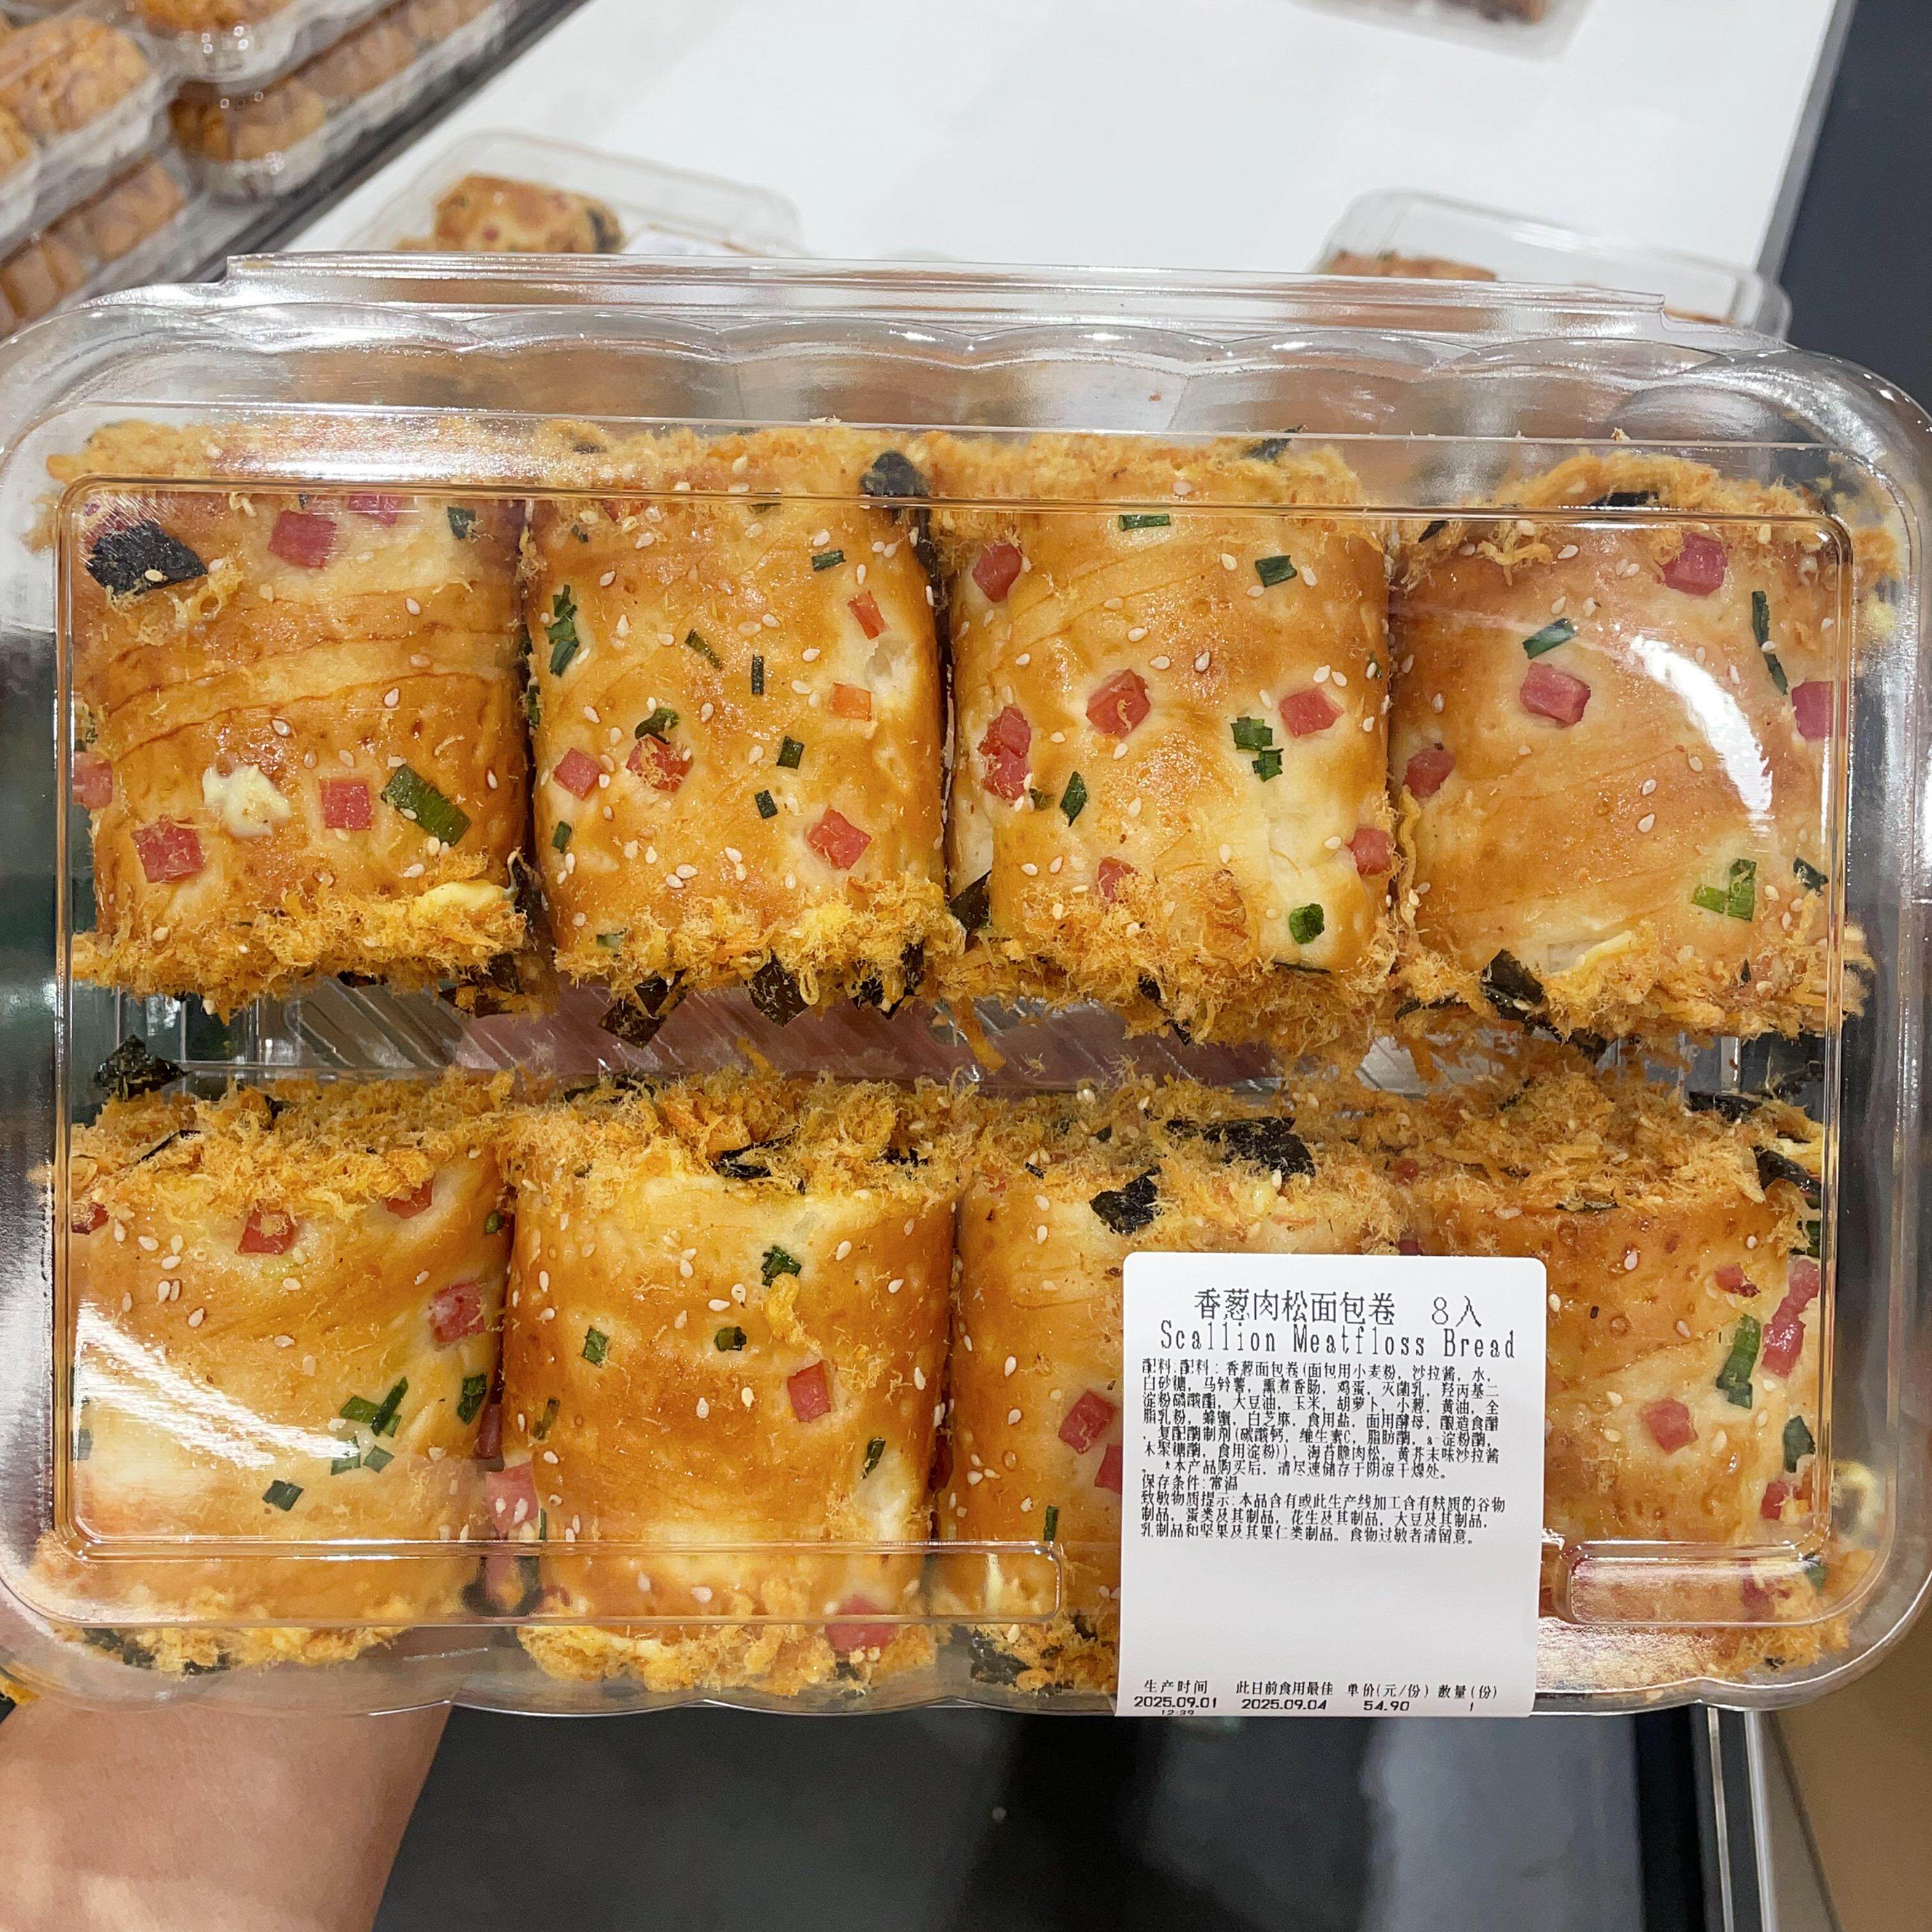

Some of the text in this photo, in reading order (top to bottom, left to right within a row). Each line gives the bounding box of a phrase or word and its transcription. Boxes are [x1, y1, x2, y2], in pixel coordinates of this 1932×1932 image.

[1195, 1288, 1395, 1324] 香葱肉松面包卷
[1161, 1320, 1515, 1358] Scallion Meatfloss Bread
[1144, 1679, 1208, 1694] 生产时间
[1236, 1680, 1333, 1696] 此日前食用最佳
[1133, 1695, 1217, 1708] 2025.09.01
[1241, 1698, 1327, 1710] 2025.09.04
[1363, 1700, 1410, 1712] 54.90
